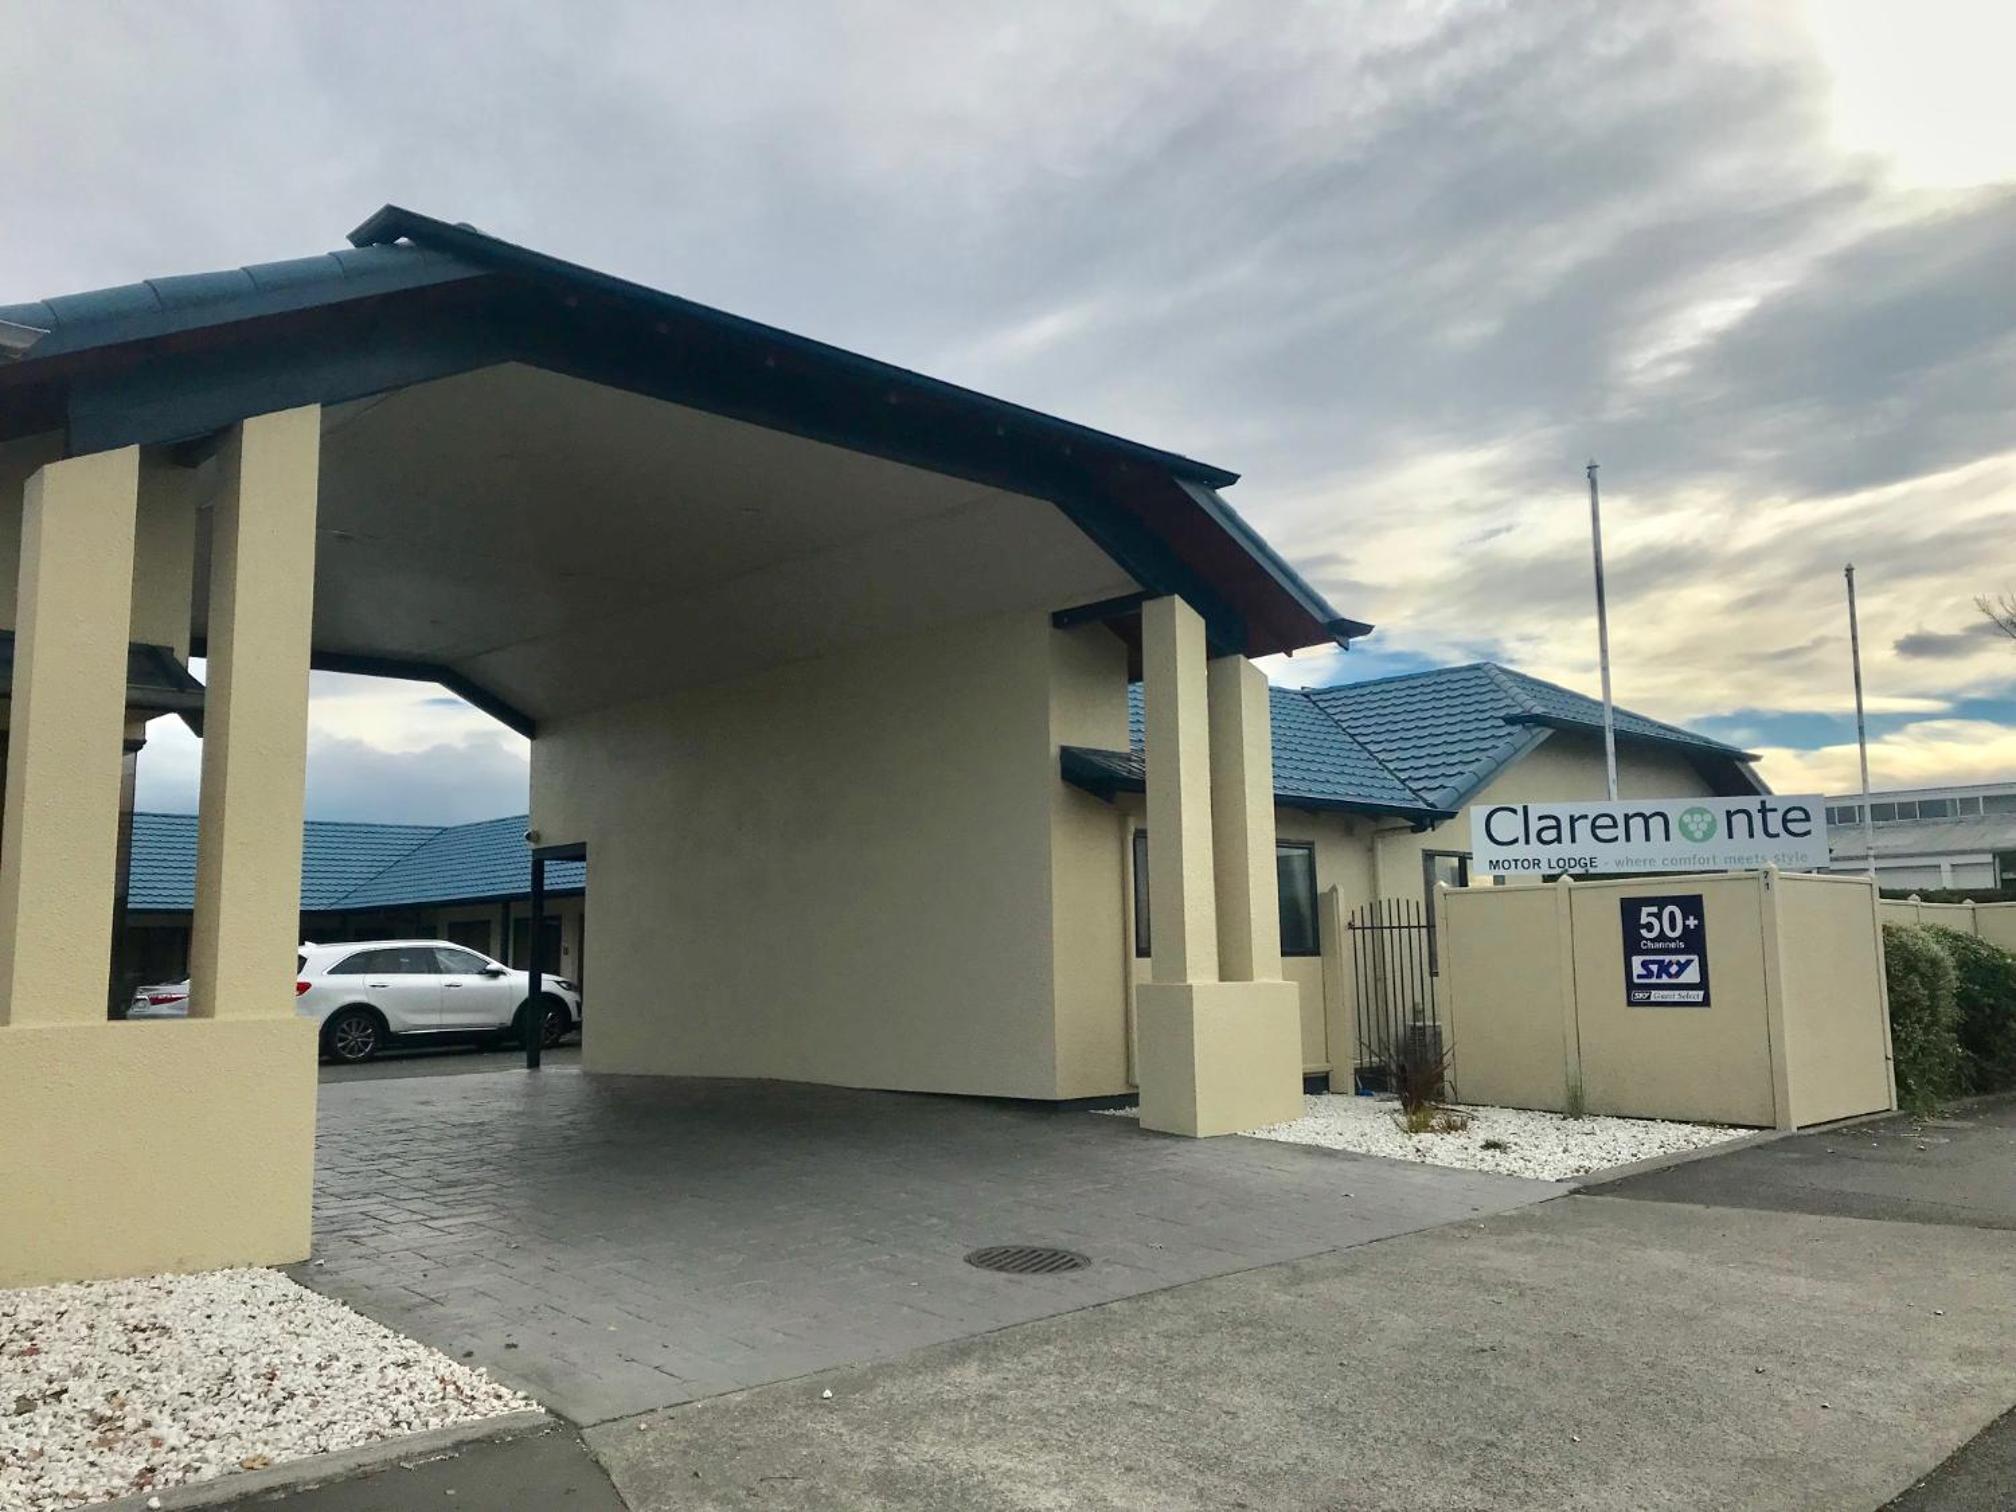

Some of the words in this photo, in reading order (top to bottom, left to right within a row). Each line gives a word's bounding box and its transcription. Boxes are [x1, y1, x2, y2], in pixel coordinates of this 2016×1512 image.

[1485, 800, 1812, 846] Claremonte
[1489, 858, 1541, 870] MOTOR
[1548, 857, 1598, 869] LODGE
[1614, 856, 1656, 868] where
[1662, 854, 1716, 867] comfort
[1724, 853, 1766, 865] meets
[1774, 851, 1808, 866] style
[1640, 905, 1698, 938] 50+
[1640, 940, 1685, 949] Channels
[1637, 959, 1695, 979] SKY
[1633, 992, 1651, 1000] SKY
